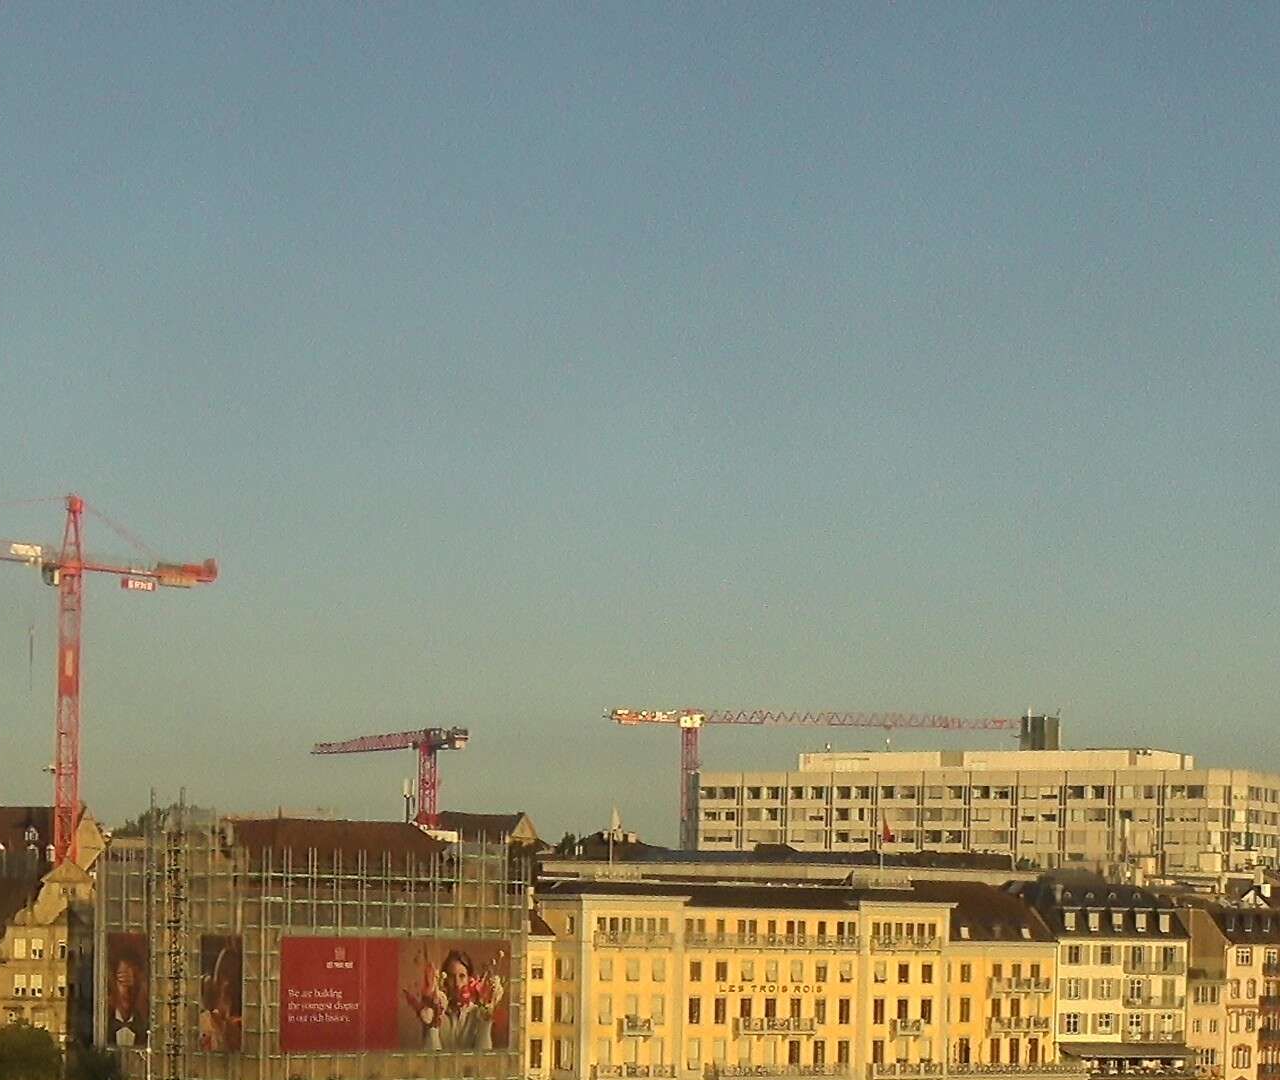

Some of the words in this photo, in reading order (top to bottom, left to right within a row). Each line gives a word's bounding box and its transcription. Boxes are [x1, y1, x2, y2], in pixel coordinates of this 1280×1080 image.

[719, 984, 744, 993] LES
[751, 984, 788, 993] TROIS
[793, 984, 824, 993] ROIS
